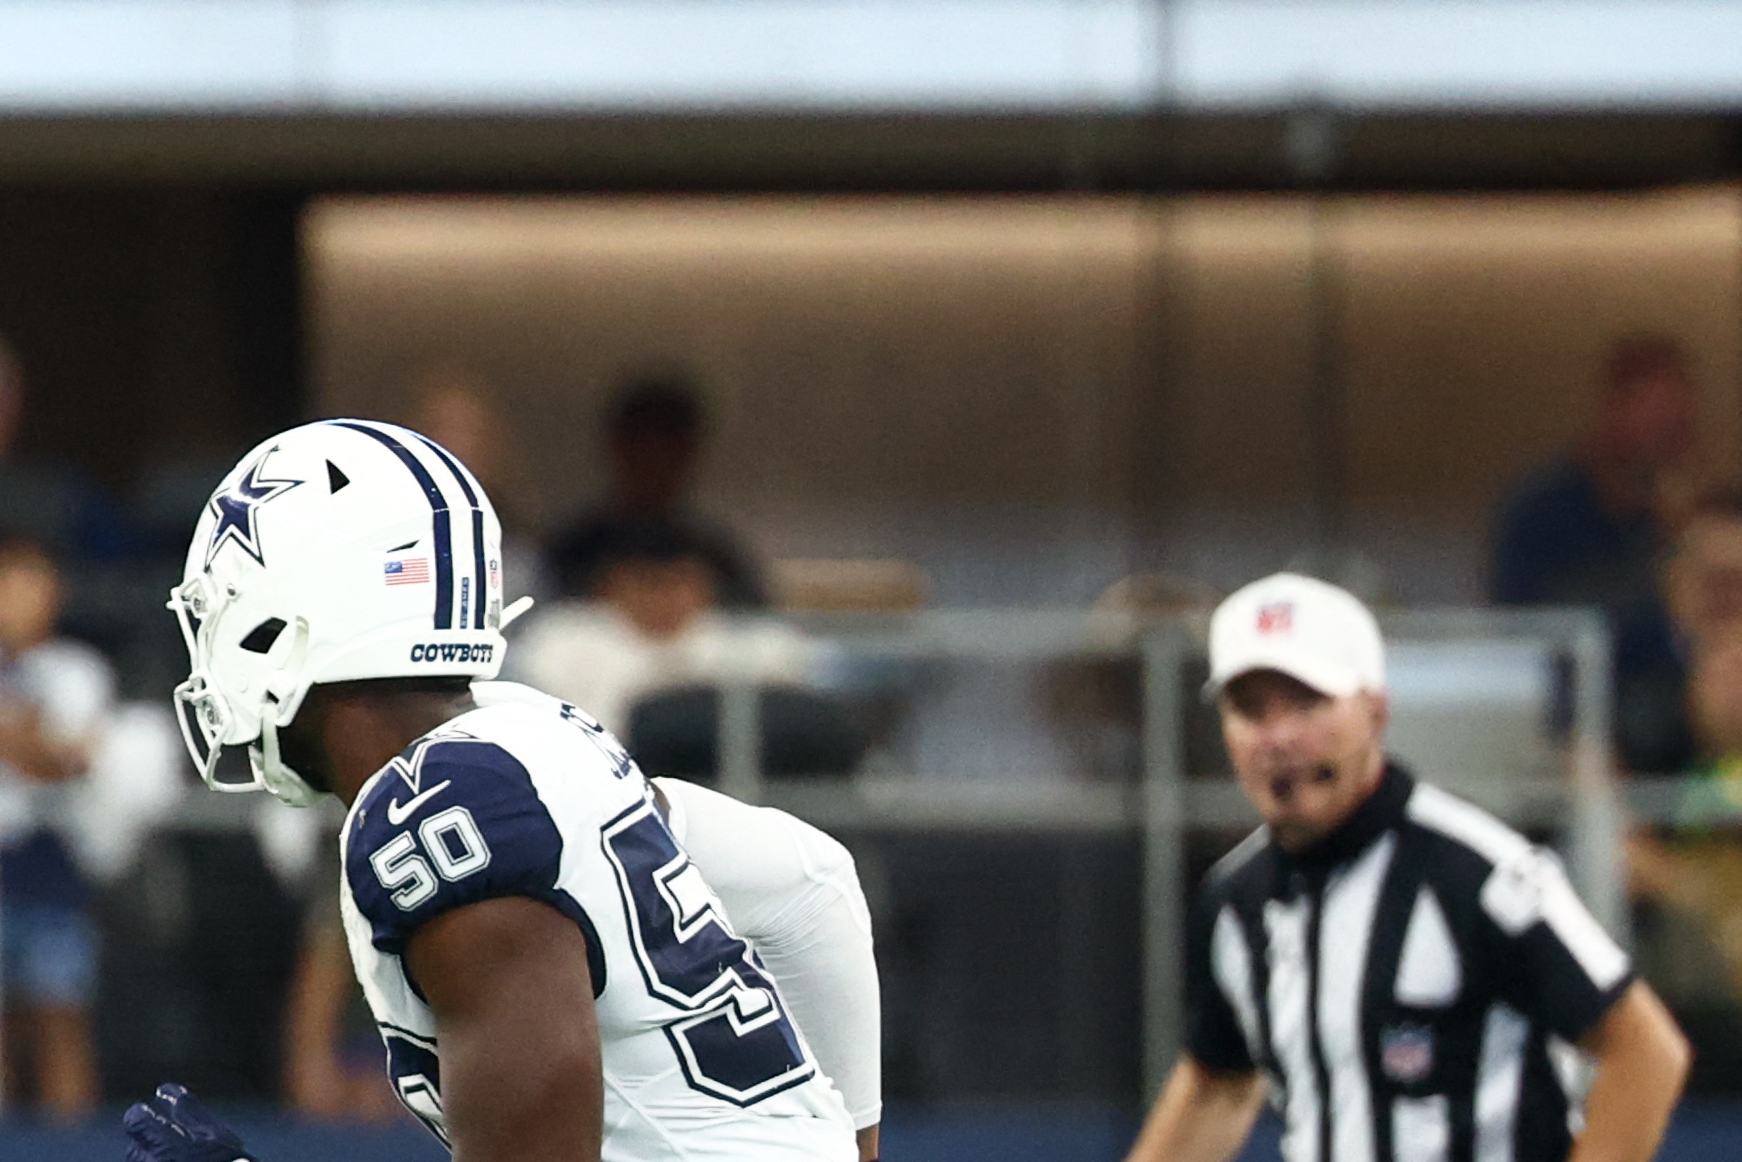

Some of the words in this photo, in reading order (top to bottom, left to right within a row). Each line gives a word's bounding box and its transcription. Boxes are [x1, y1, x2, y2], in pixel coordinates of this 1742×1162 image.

[410, 643, 494, 663] COWBOYS
[368, 805, 493, 912] 50
[599, 797, 817, 1109] 5
